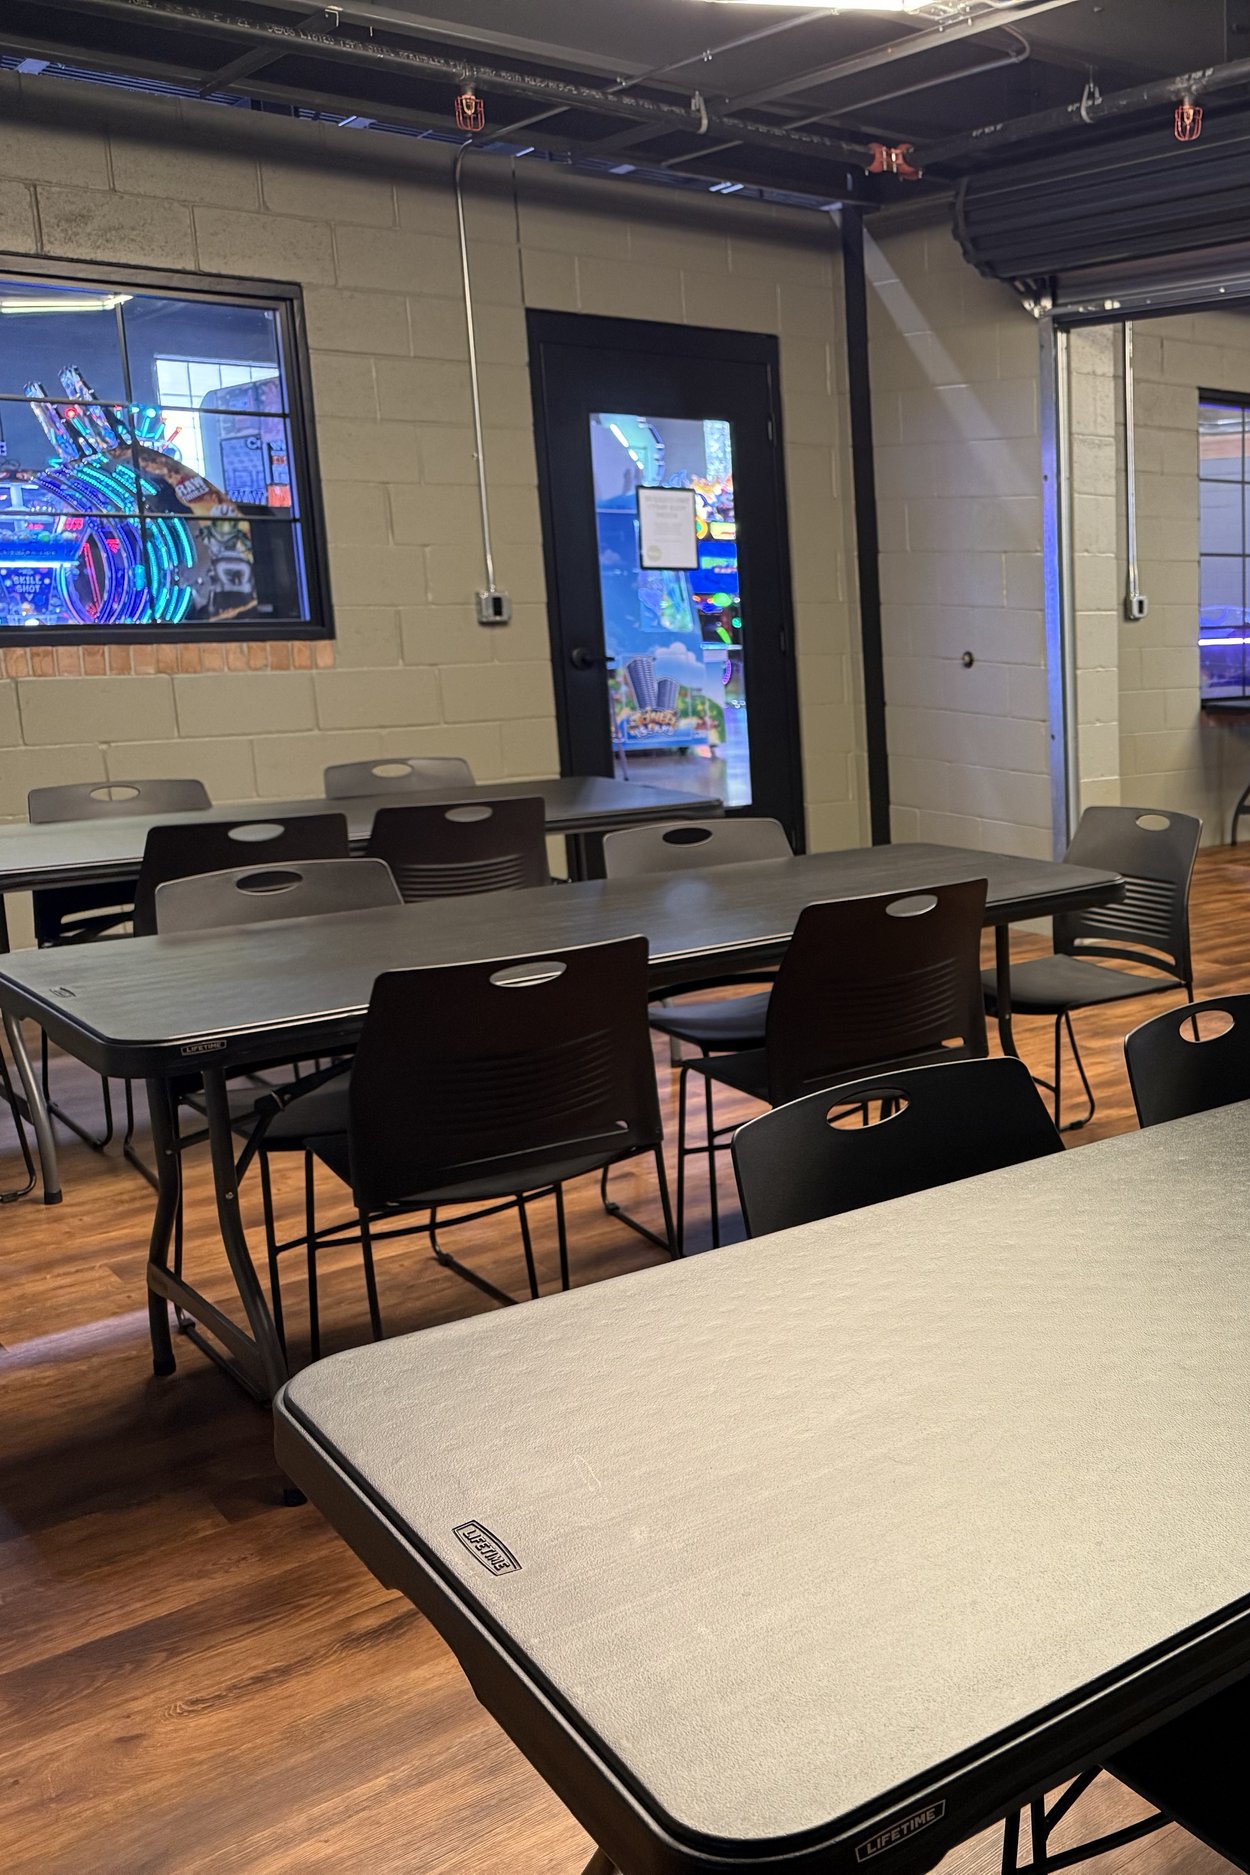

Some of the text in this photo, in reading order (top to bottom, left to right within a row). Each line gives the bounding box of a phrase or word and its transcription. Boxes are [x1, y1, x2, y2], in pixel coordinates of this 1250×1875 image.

[12, 575, 43, 585] SKILL
[15, 584, 41, 593] SHOT
[186, 1043, 221, 1053] LIFETIME
[463, 1529, 511, 1571] LIFETIME
[867, 1808, 936, 1854] LIFETIME
